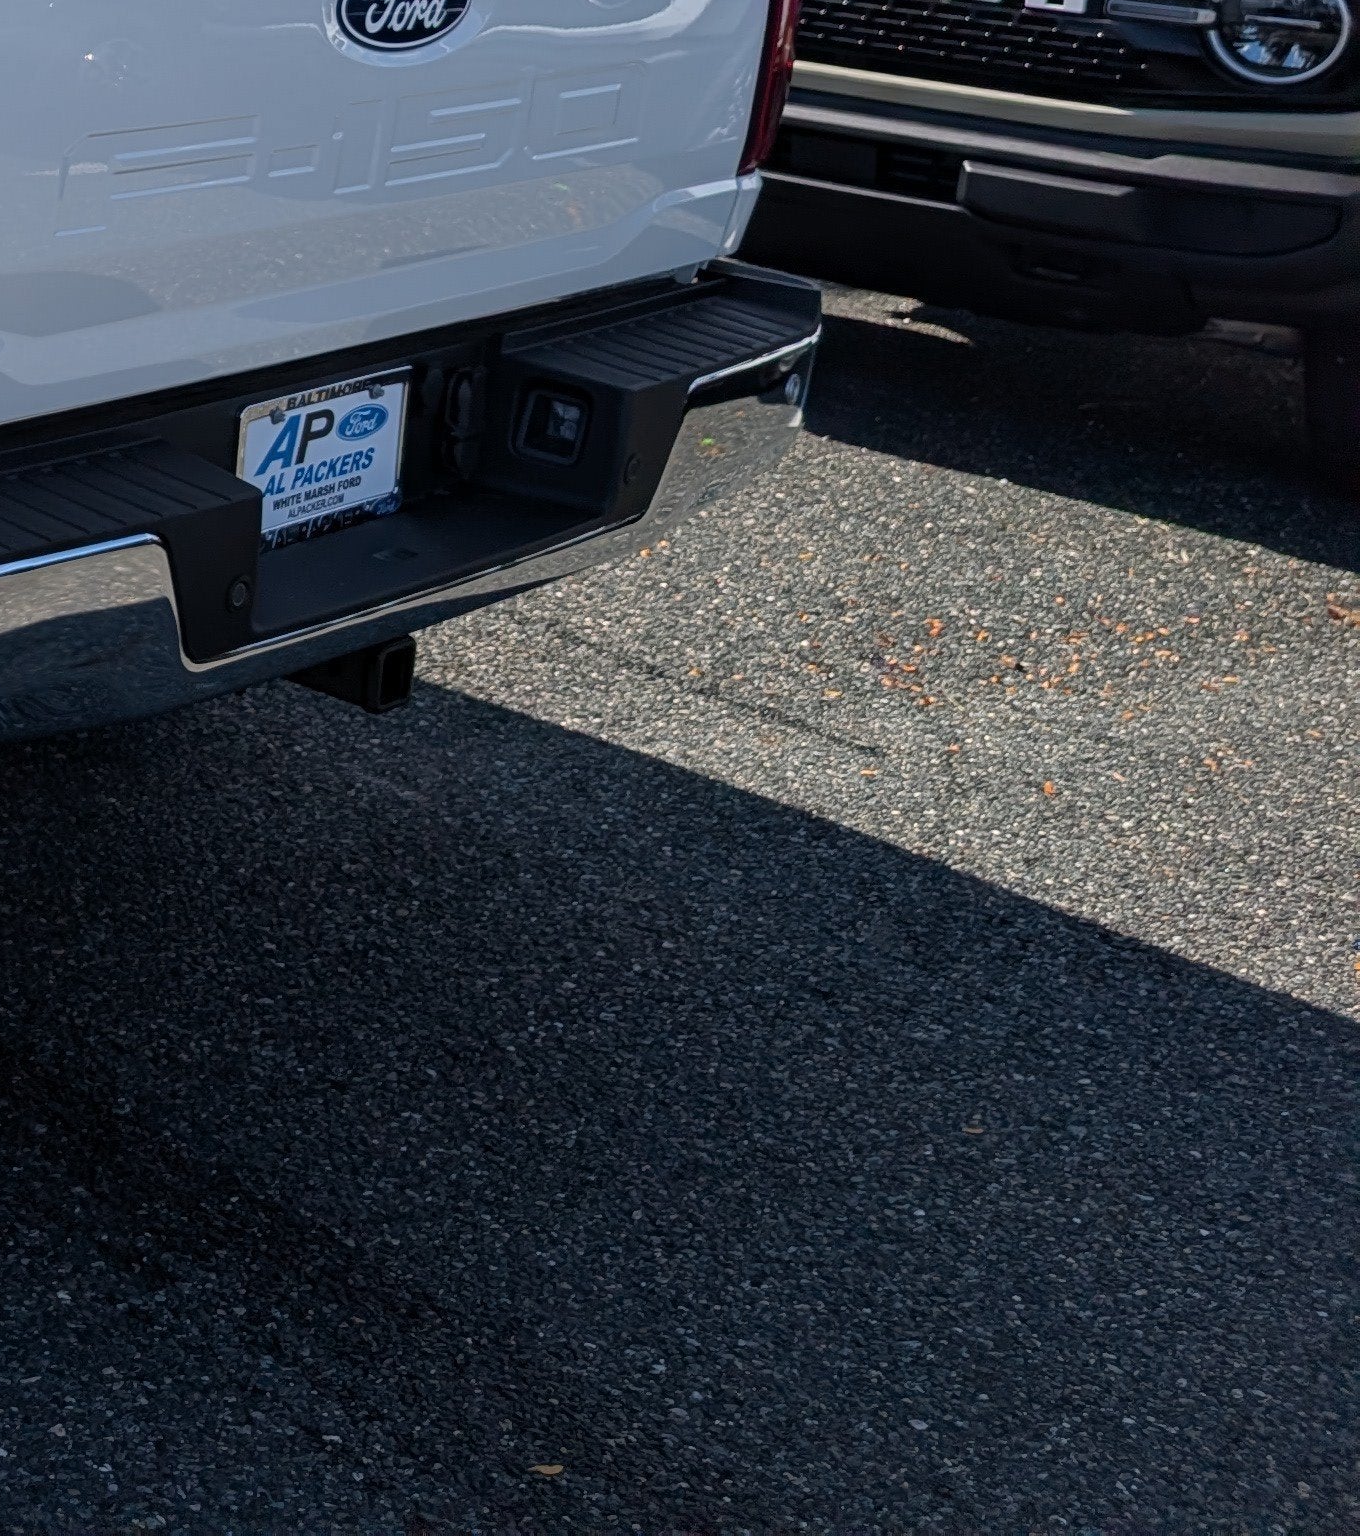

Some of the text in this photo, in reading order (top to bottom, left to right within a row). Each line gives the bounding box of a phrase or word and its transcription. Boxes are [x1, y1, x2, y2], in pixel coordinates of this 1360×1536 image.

[54, 62, 646, 237] F-150
[285, 380, 371, 411] BALTIMORE
[345, 410, 377, 435] Ford
[254, 409, 334, 477] AP
[263, 447, 375, 498] AL PACKERS
[272, 475, 362, 511] WHITE MARSH FORD
[286, 493, 345, 519] ALPACKER.COM
